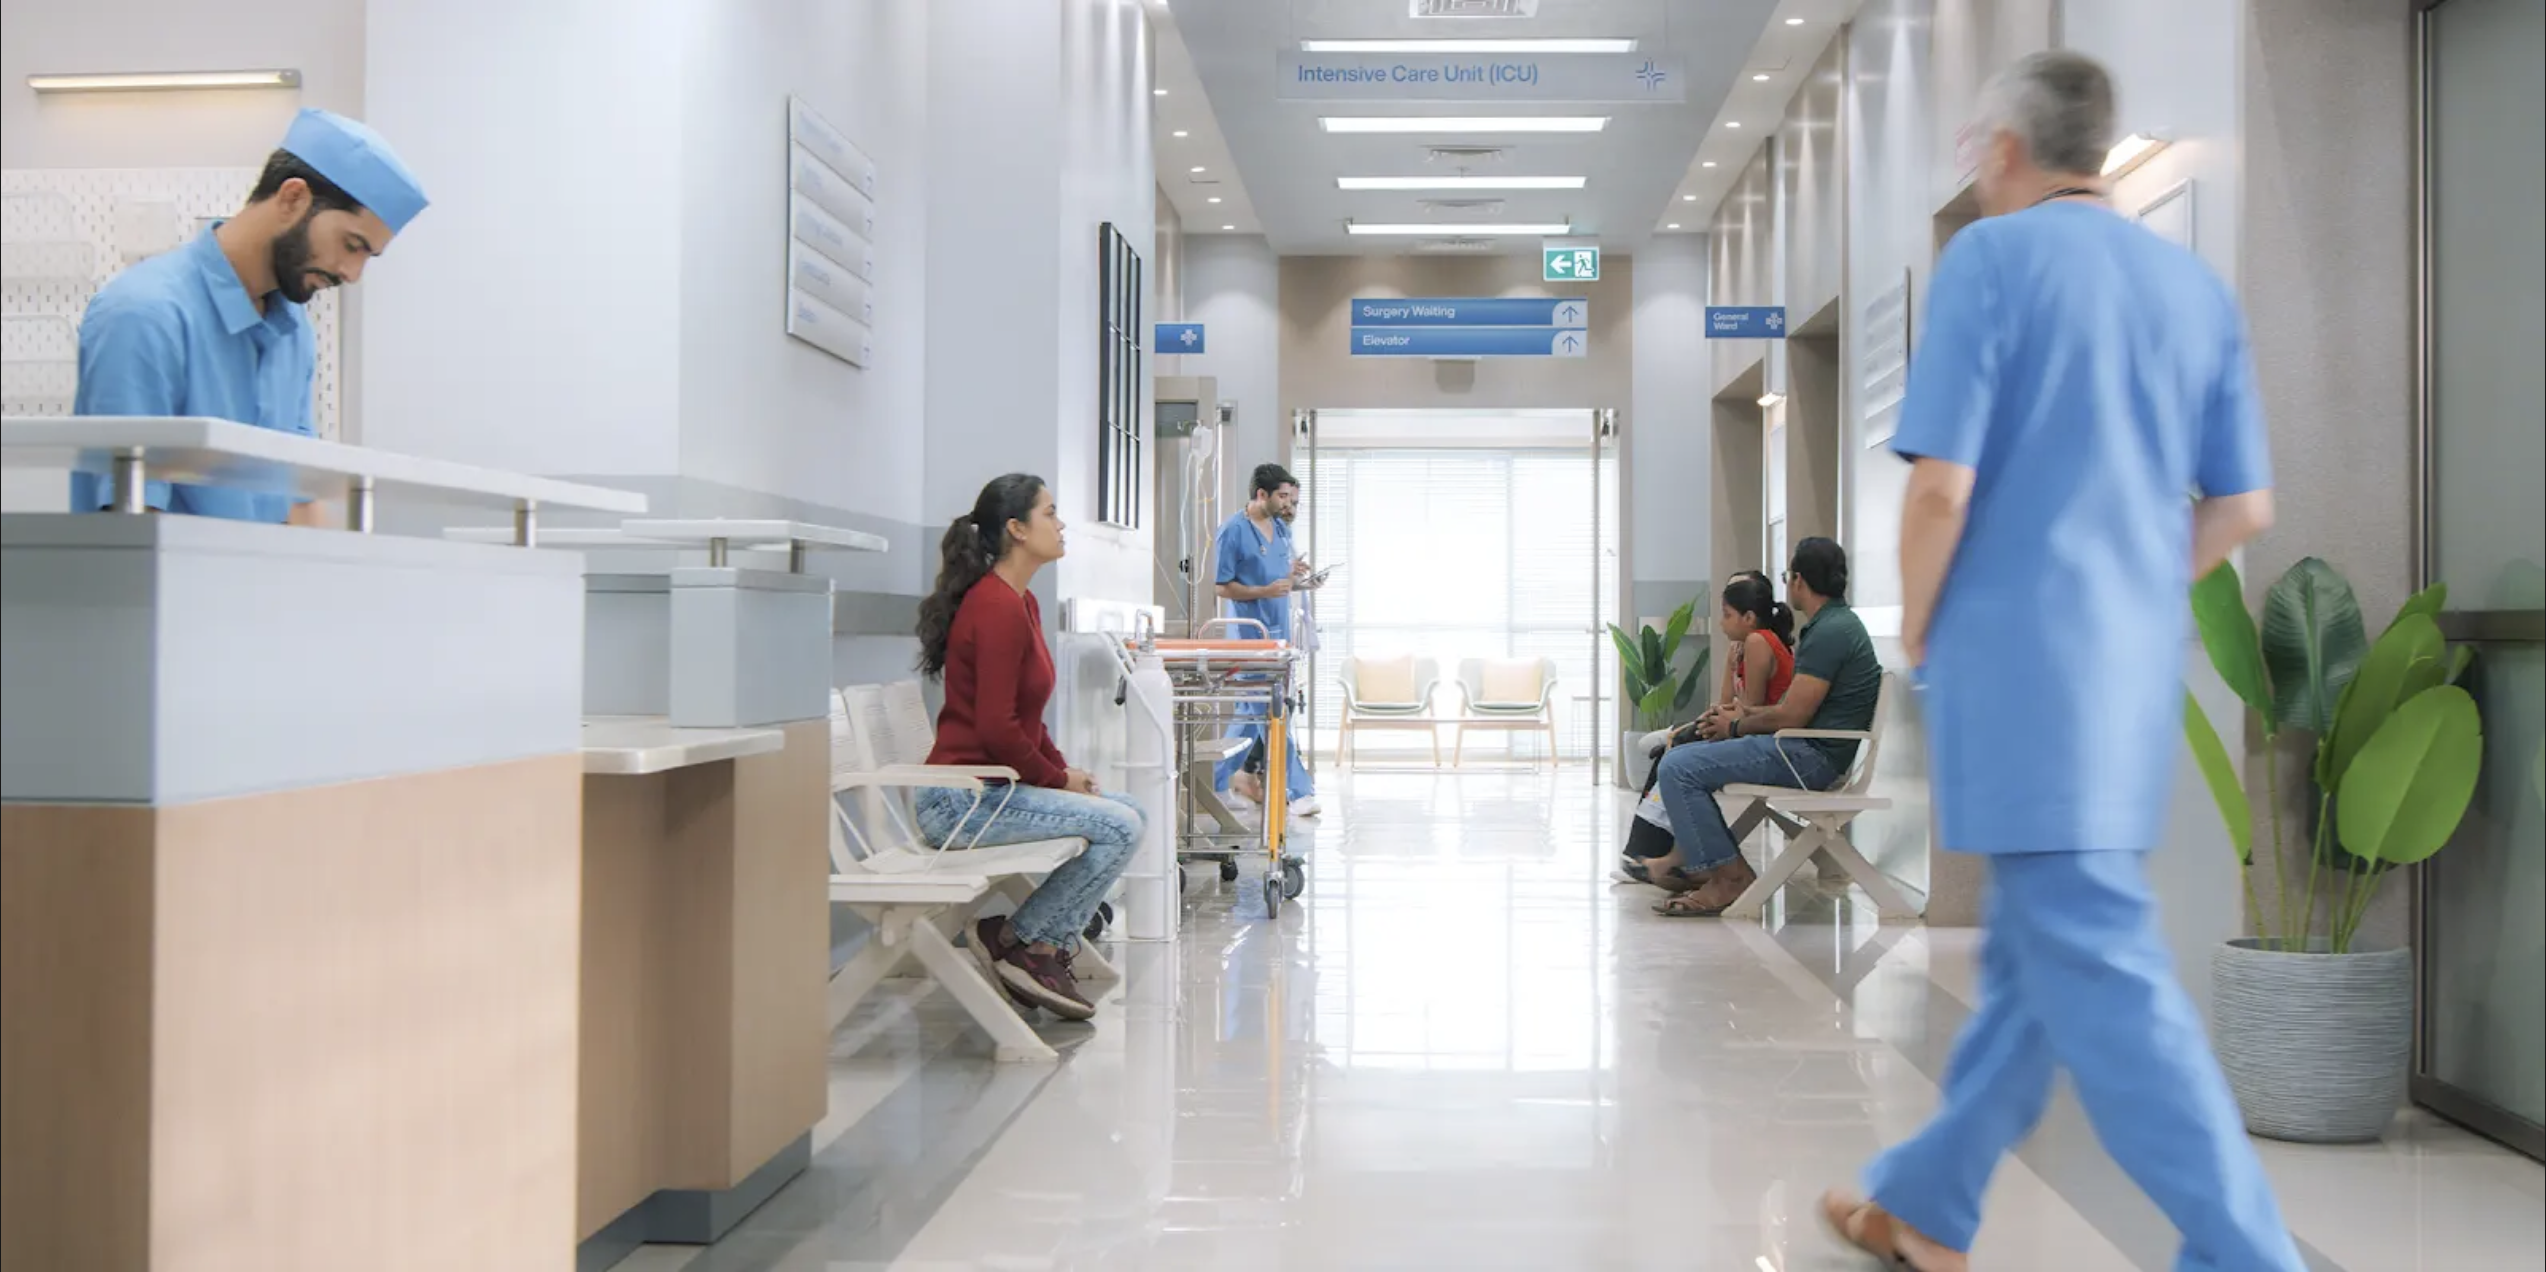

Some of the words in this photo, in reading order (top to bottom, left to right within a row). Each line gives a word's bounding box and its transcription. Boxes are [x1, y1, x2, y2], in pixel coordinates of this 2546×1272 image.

[1298, 64, 1387, 82] Intensive
[1391, 64, 1439, 82] Care
[1444, 64, 1484, 82] Unit
[1489, 63, 1538, 87] (ICU)
[1363, 305, 1410, 319] Surgery
[1411, 305, 1456, 319] Waiting
[1713, 312, 1749, 321] General
[1713, 321, 1738, 330] Ward
[1363, 335, 1411, 346] Elevator
